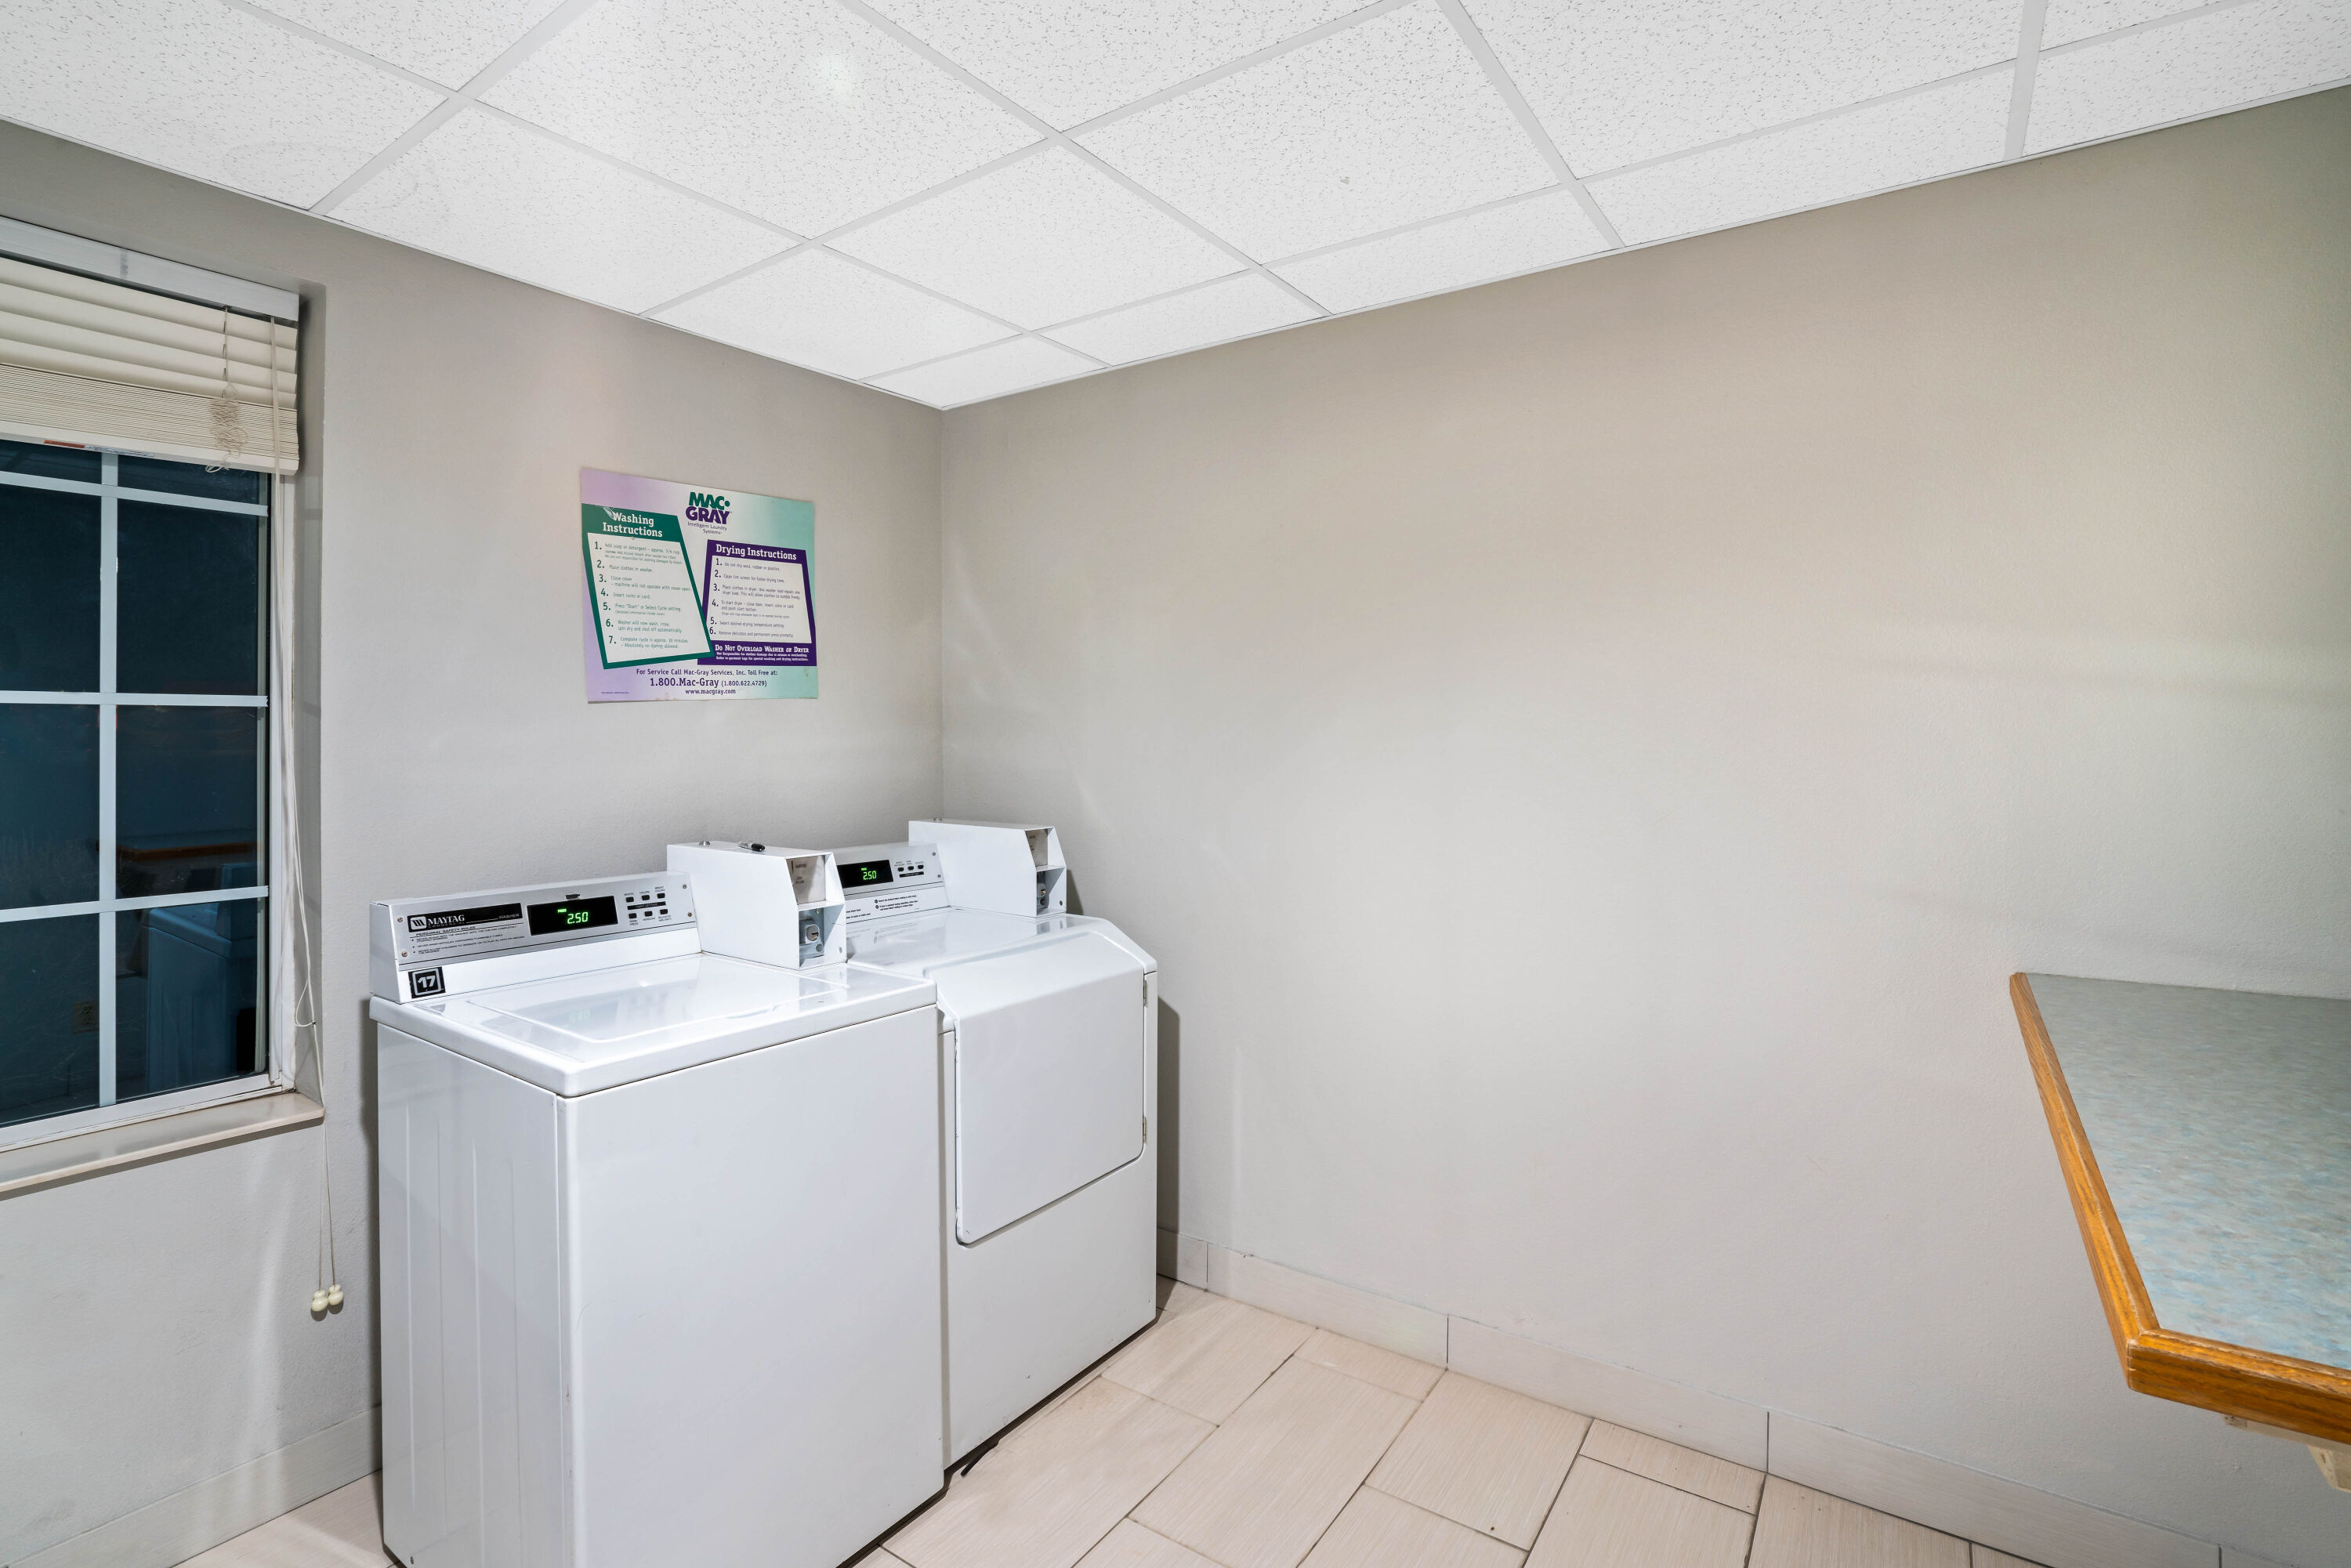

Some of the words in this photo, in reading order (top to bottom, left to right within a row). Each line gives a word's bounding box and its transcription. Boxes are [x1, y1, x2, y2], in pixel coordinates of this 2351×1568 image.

[613, 512, 654, 527] Washing
[686, 506, 730, 524] GRAY
[603, 522, 662, 537] Instructions
[716, 544, 744, 556] Drying
[748, 548, 796, 559] Instructions
[597, 559, 604, 568] 2.
[650, 678, 719, 688] 1.800.Mac-Gray
[428, 914, 464, 925] MAYTAG
[567, 912, 588, 924] 2.50
[418, 976, 435, 988] 17
